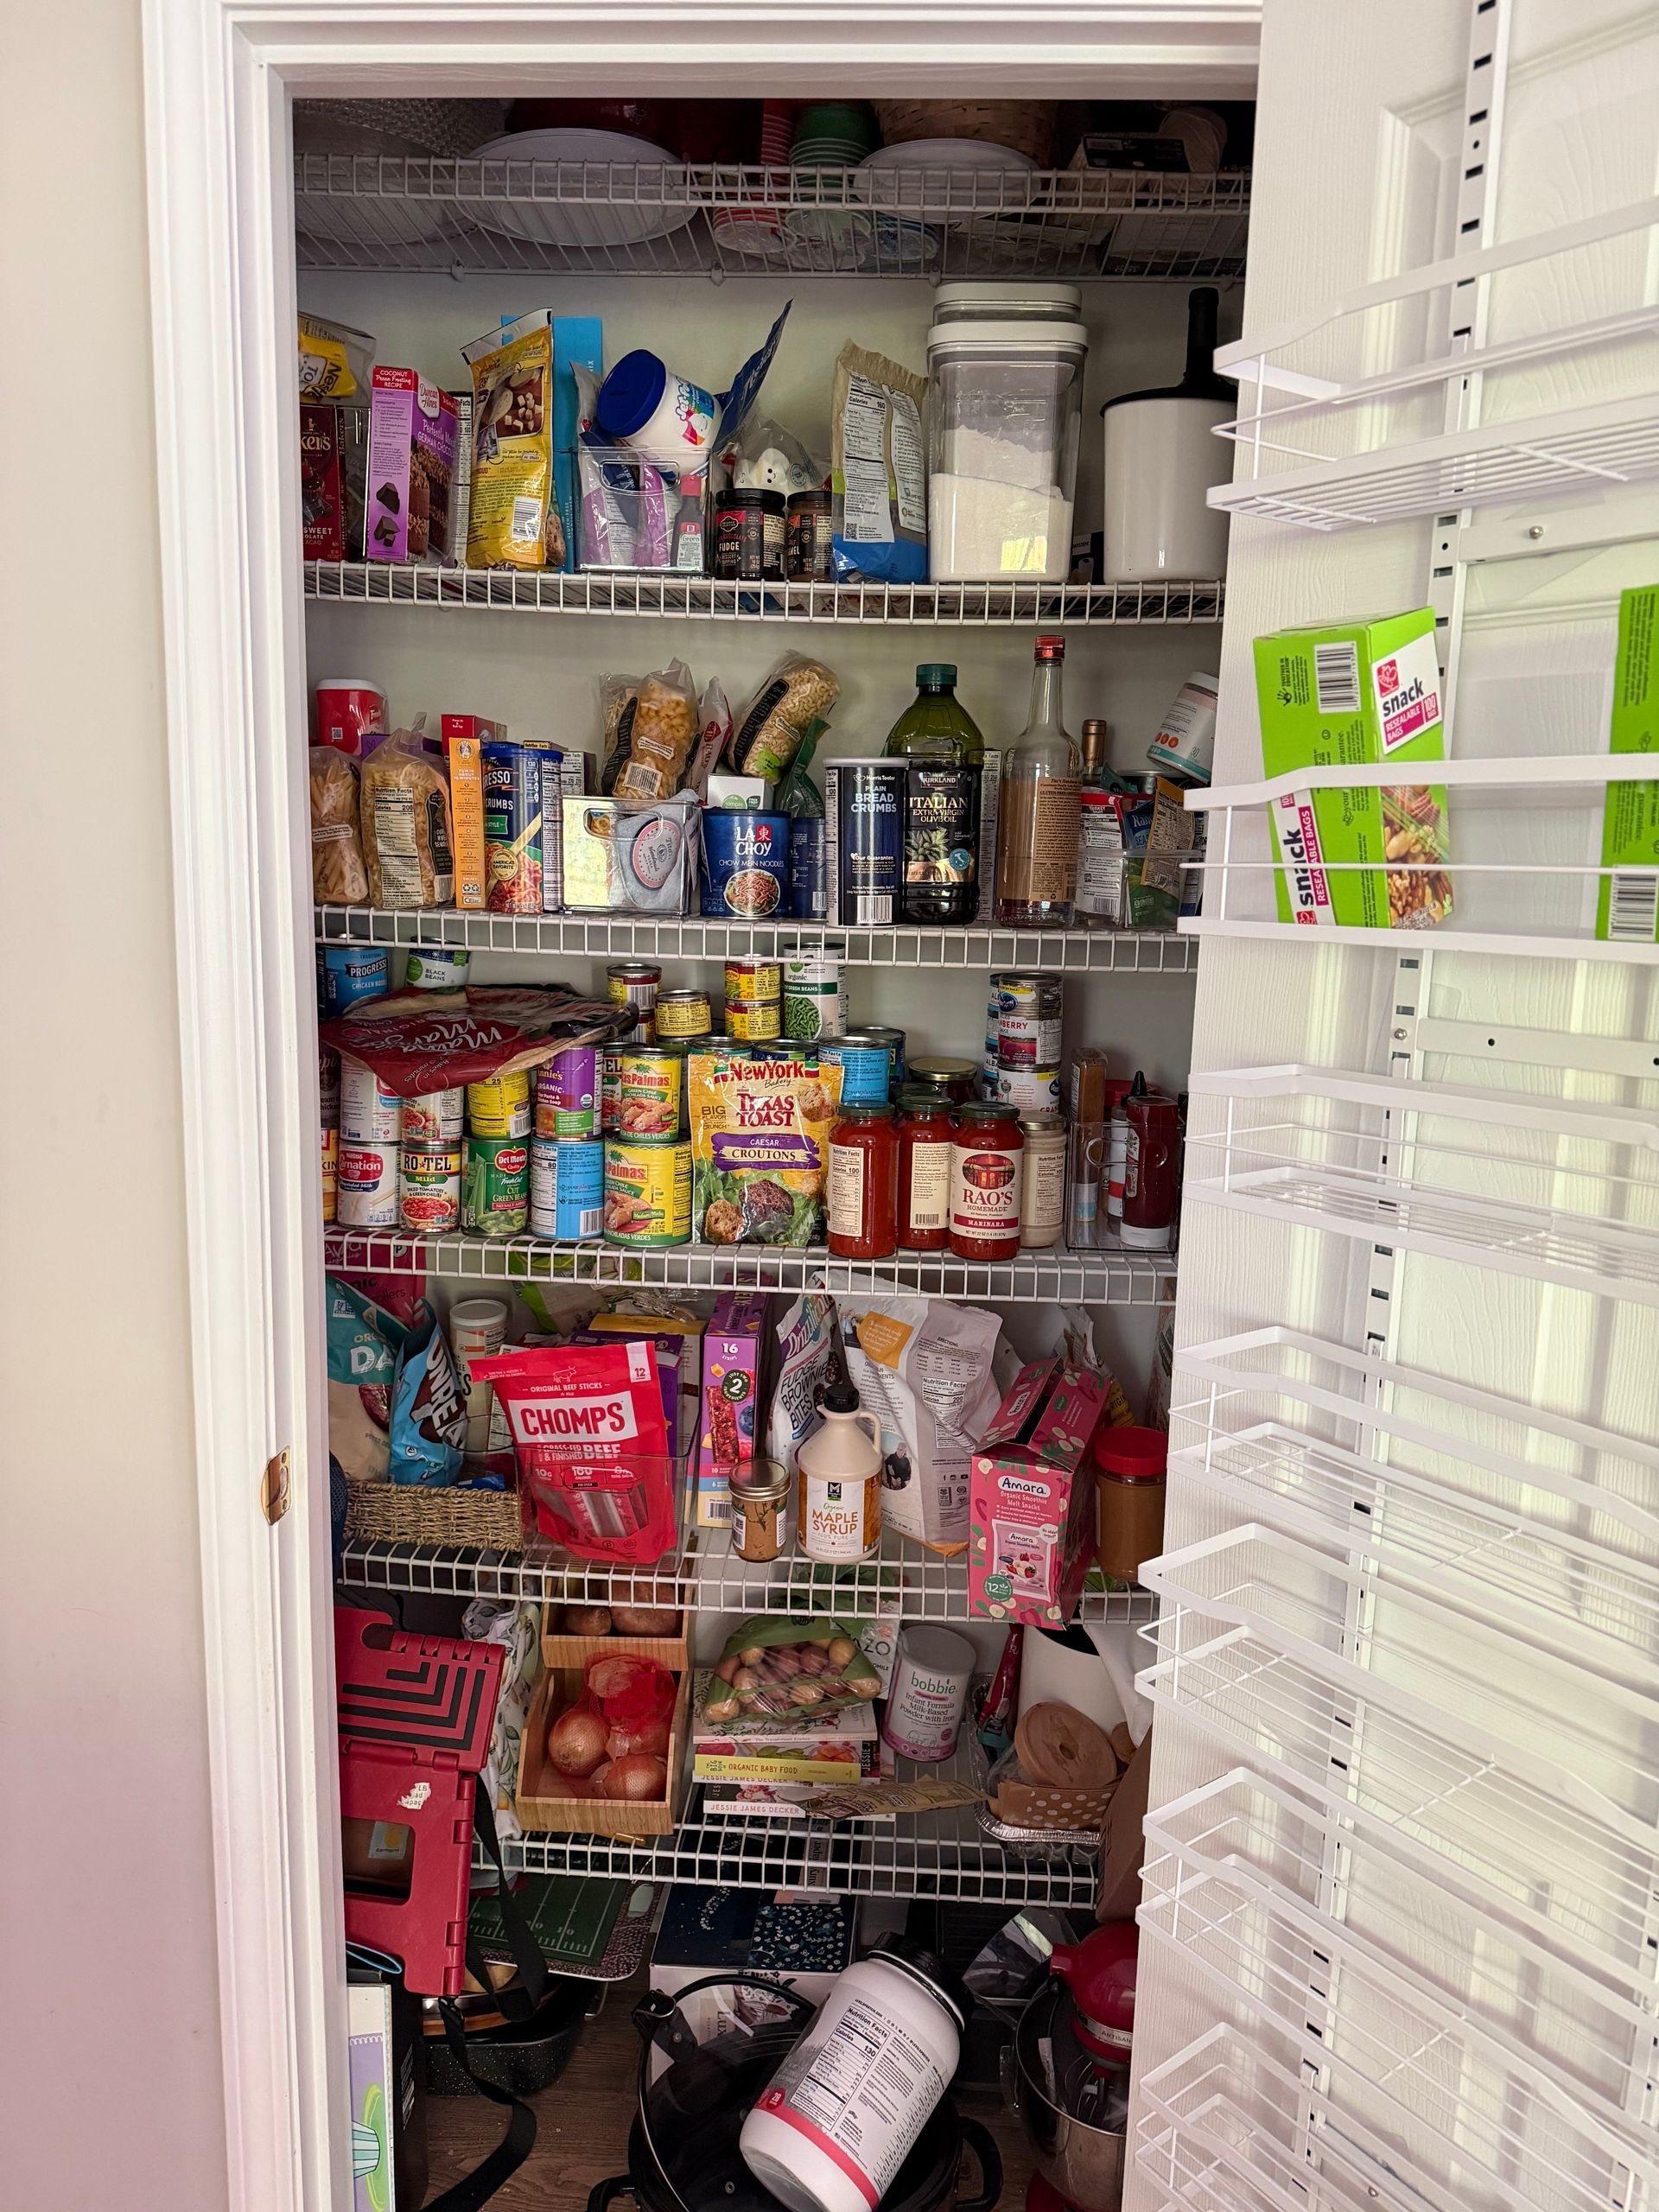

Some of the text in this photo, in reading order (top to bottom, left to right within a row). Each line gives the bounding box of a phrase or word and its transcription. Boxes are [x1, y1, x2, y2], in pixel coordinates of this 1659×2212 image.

[379, 369, 408, 378] COCONUT
[391, 376, 411, 385] Frosting
[419, 383, 438, 397] Duncan
[421, 396, 437, 409] Hines
[849, 396, 886, 410] Calories 160
[301, 433, 332, 451] ker's
[719, 542, 740, 551] FUDGE
[1382, 677, 1424, 717] snack
[1423, 695, 1436, 712] 100
[1385, 704, 1421, 732] RESEALABLE
[1387, 726, 1403, 742] BAGS
[1190, 746, 1199, 758] 30
[855, 793, 894, 803] BREAD
[909, 797, 968, 809] ITALIAN
[850, 803, 897, 813] CRUMBS
[736, 827, 755, 842] LA
[735, 842, 772, 856] CHOY
[1301, 810, 1325, 902] RESEAABLE BAGS
[1282, 828, 1314, 906] snack
[352, 982, 374, 990] CHICKEN
[403, 1063, 429, 1084] minutes
[632, 1073, 670, 1086] Palmas
[764, 1078, 791, 1090] Bakery
[736, 1093, 795, 1110] TEXAS
[701, 1105, 726, 1116] BIG
[736, 1110, 795, 1127] TOAST
[731, 1149, 796, 1160] CROUTONS
[493, 1193, 513, 1202] GREEN
[963, 1189, 1013, 1206] RAO'S
[722, 1342, 739, 1354] 16
[938, 1337, 959, 1348] DIRECTIONS
[634, 1367, 646, 1377] 12
[740, 1372, 748, 1382] TWO
[780, 1355, 820, 1394] FUDGE
[530, 1382, 602, 1393] ORIGINAL BEEF STICKS
[730, 1377, 743, 1395] 2
[781, 1361, 830, 1413] BROWNIE
[923, 1377, 949, 1387] Nutrition
[923, 1395, 940, 1403] Calories
[520, 1402, 626, 1436] CHOMPS
[790, 1394, 813, 1431] BITES
[552, 1452, 583, 1461] FINISHED
[582, 1443, 621, 1459] BEEF
[1001, 1491, 1047, 1504] Organic Smoothie
[1021, 1502, 1040, 1511] Snacks
[812, 1509, 859, 1523] MAPLE
[812, 1519, 857, 1535] SYRUP
[988, 1582, 999, 1593] 12
[905, 1692, 925, 1706] Infant
[927, 1699, 955, 1709] Formula
[899, 1703, 925, 1719] Powder
[909, 1702, 949, 1716] Milk-Based
[861, 1746, 871, 1771] JESSIE
[728, 1764, 798, 1775] ORGANIC BABY FOOD
[848, 2007, 888, 2038] Nutrition Facts
[835, 2026, 855, 2042] Calories
[1101, 2031, 1132, 2044] ARTISAN
[863, 2044, 876, 2057] 130
[771, 2092, 782, 2102] 28
